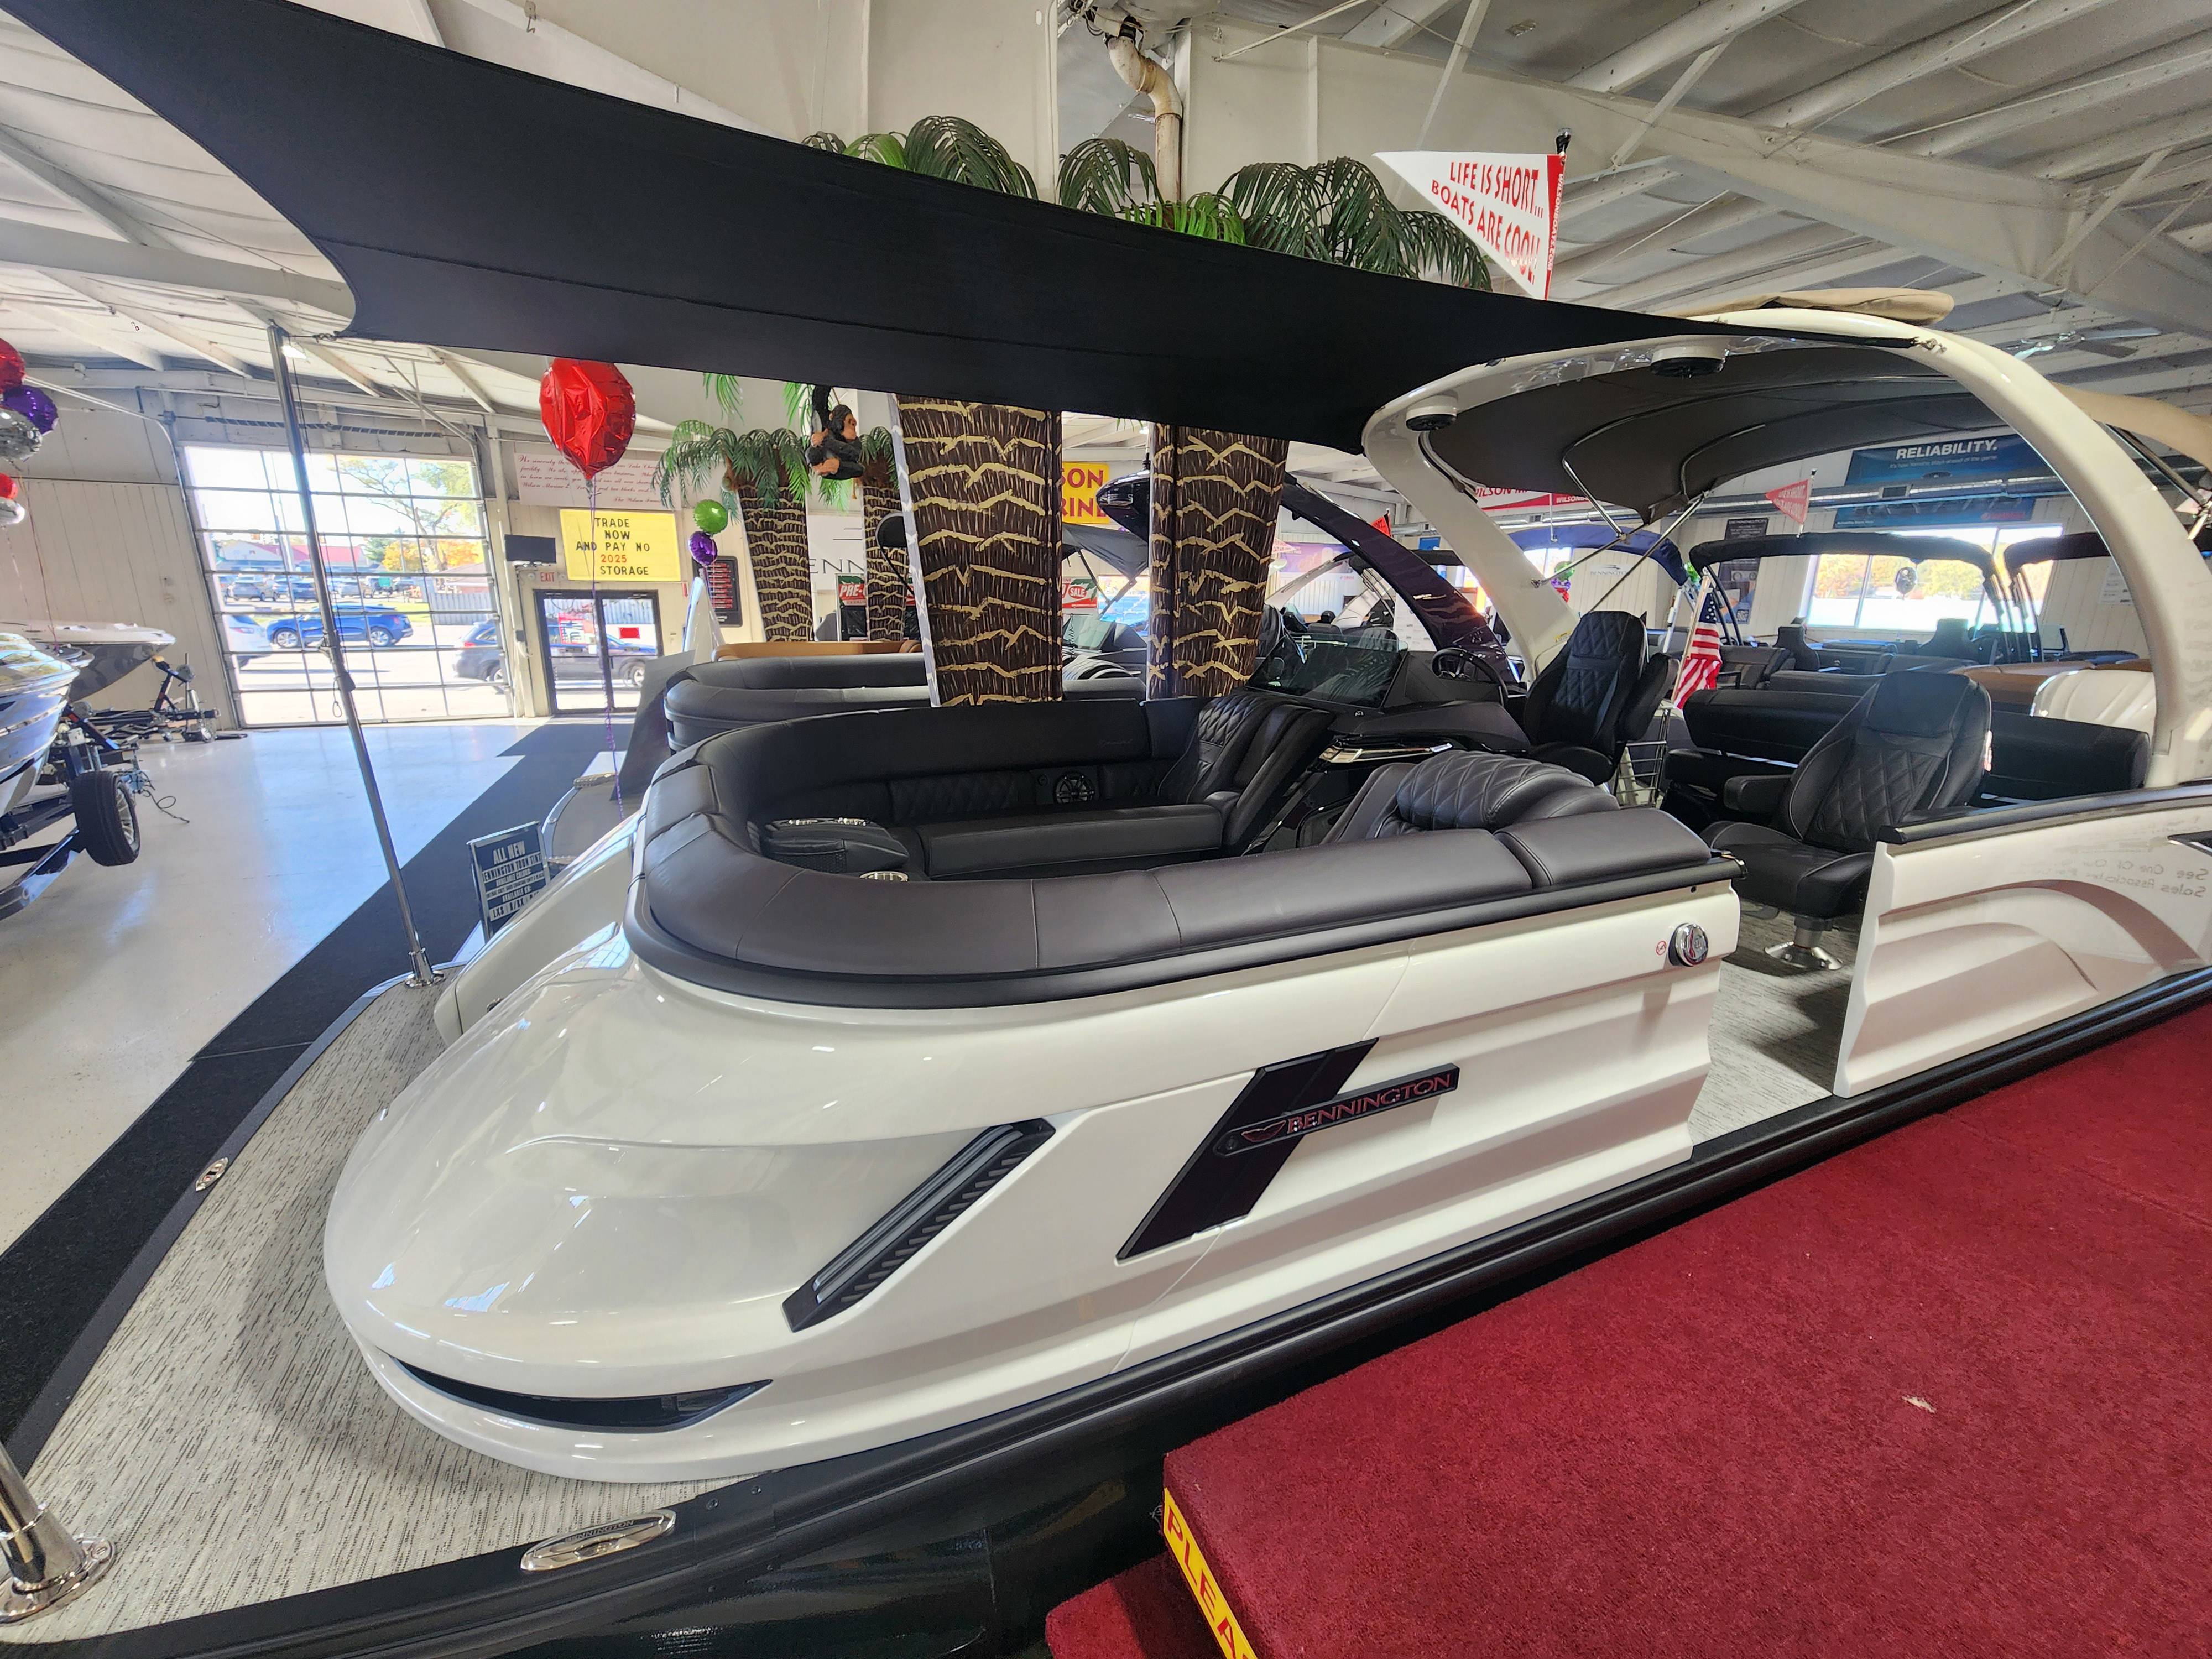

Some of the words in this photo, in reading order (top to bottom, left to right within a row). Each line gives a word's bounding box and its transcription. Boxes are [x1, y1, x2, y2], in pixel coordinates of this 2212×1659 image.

[1449, 161, 1478, 191] LIFE
[1480, 164, 1493, 195] IS
[1431, 179, 1475, 226] BOATS
[1476, 206, 1504, 253] ARE
[1896, 439, 1998, 460] RELIABILITY.
[594, 517, 630, 528] TRADE
[604, 530, 630, 540] NOW
[576, 541, 597, 551] AND
[605, 542, 626, 552] PAY
[635, 542, 650, 552] NO
[600, 554, 628, 564] 2025
[540, 572, 555, 582] EXIT
[599, 566, 649, 576] STORAGE
[1069, 588, 1086, 597] SALE
[493, 847, 508, 865] ALL
[507, 840, 526, 859] NEW
[483, 863, 515, 882] ENNINGTON
[1287, 1073, 1452, 1134] BENNINGTON
[1166, 1505, 1246, 1659] PLEA
